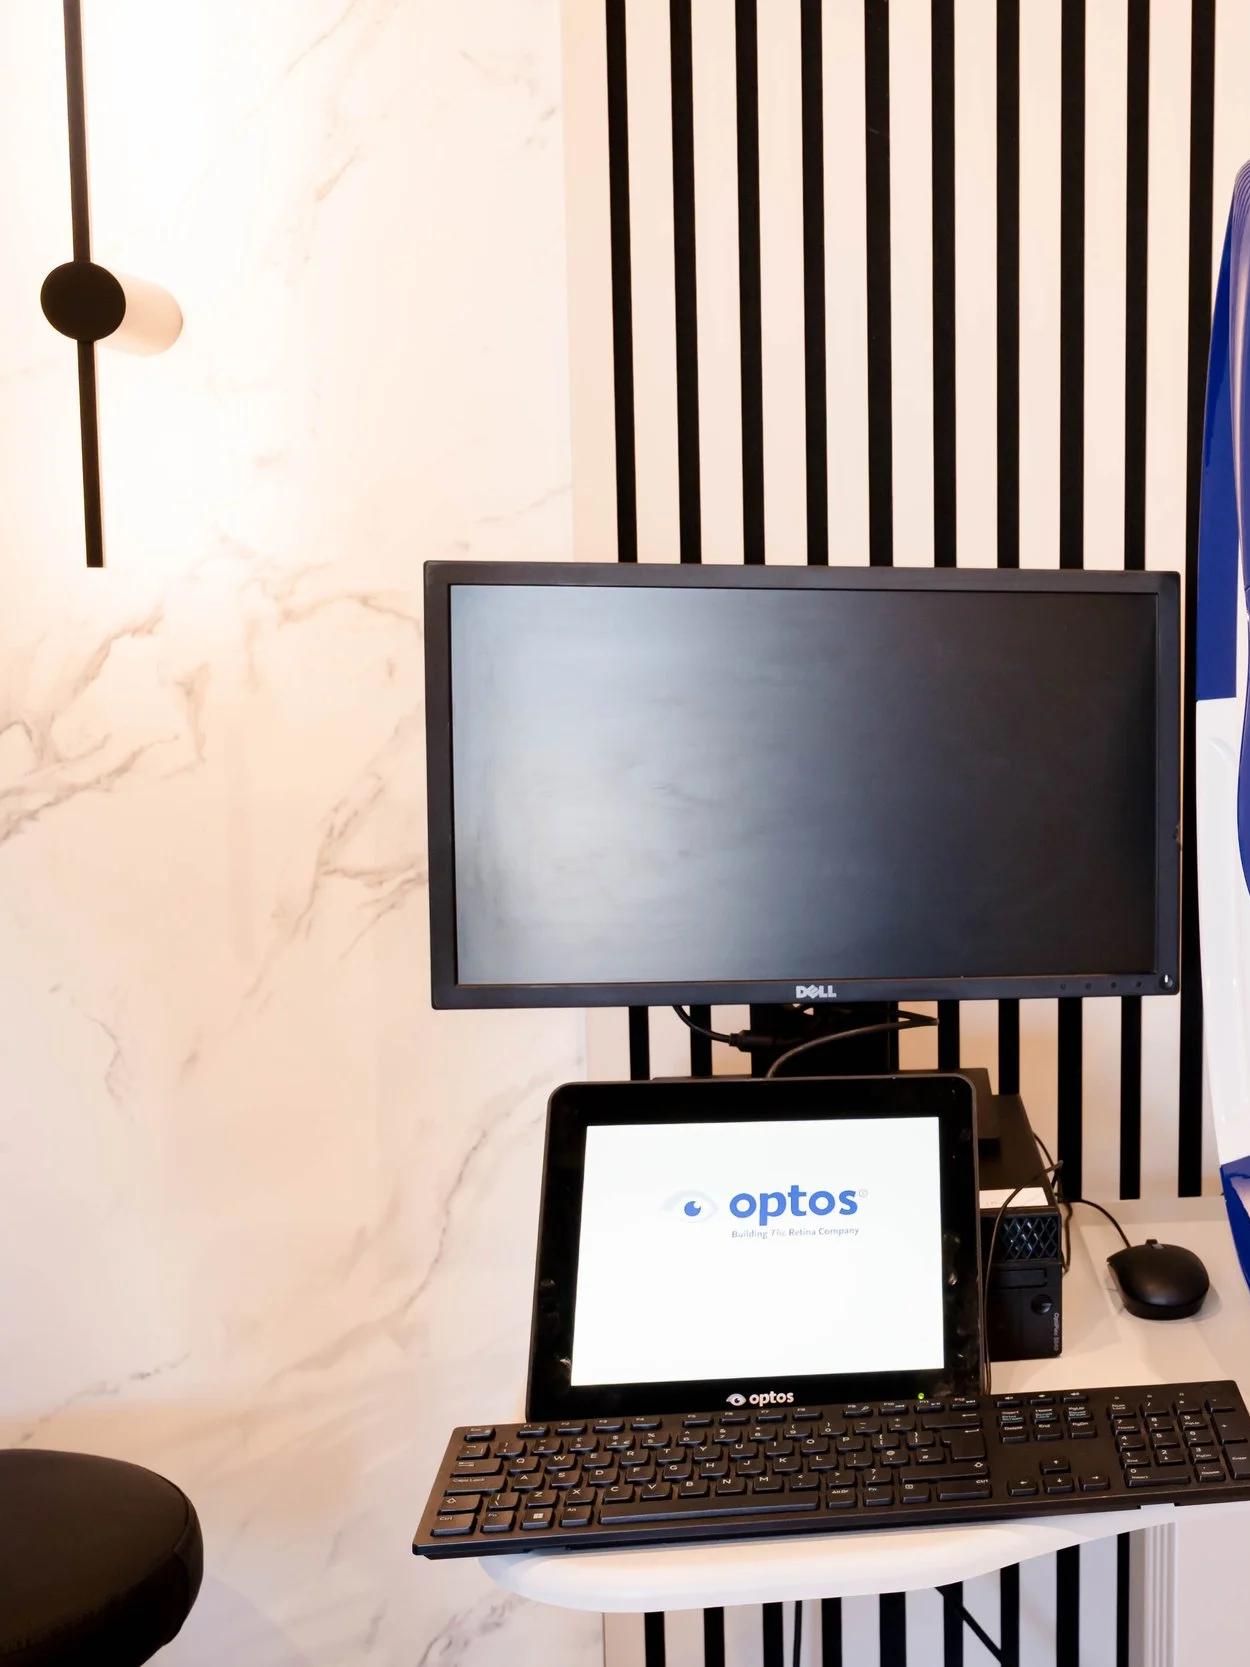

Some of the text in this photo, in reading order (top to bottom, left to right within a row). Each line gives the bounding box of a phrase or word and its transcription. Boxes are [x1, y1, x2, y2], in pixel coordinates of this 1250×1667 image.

[795, 984, 837, 999] DELL
[731, 1230, 768, 1239] Building
[788, 1227, 816, 1237] Retina
[818, 1227, 859, 1237] Company
[749, 1390, 794, 1407] optos
